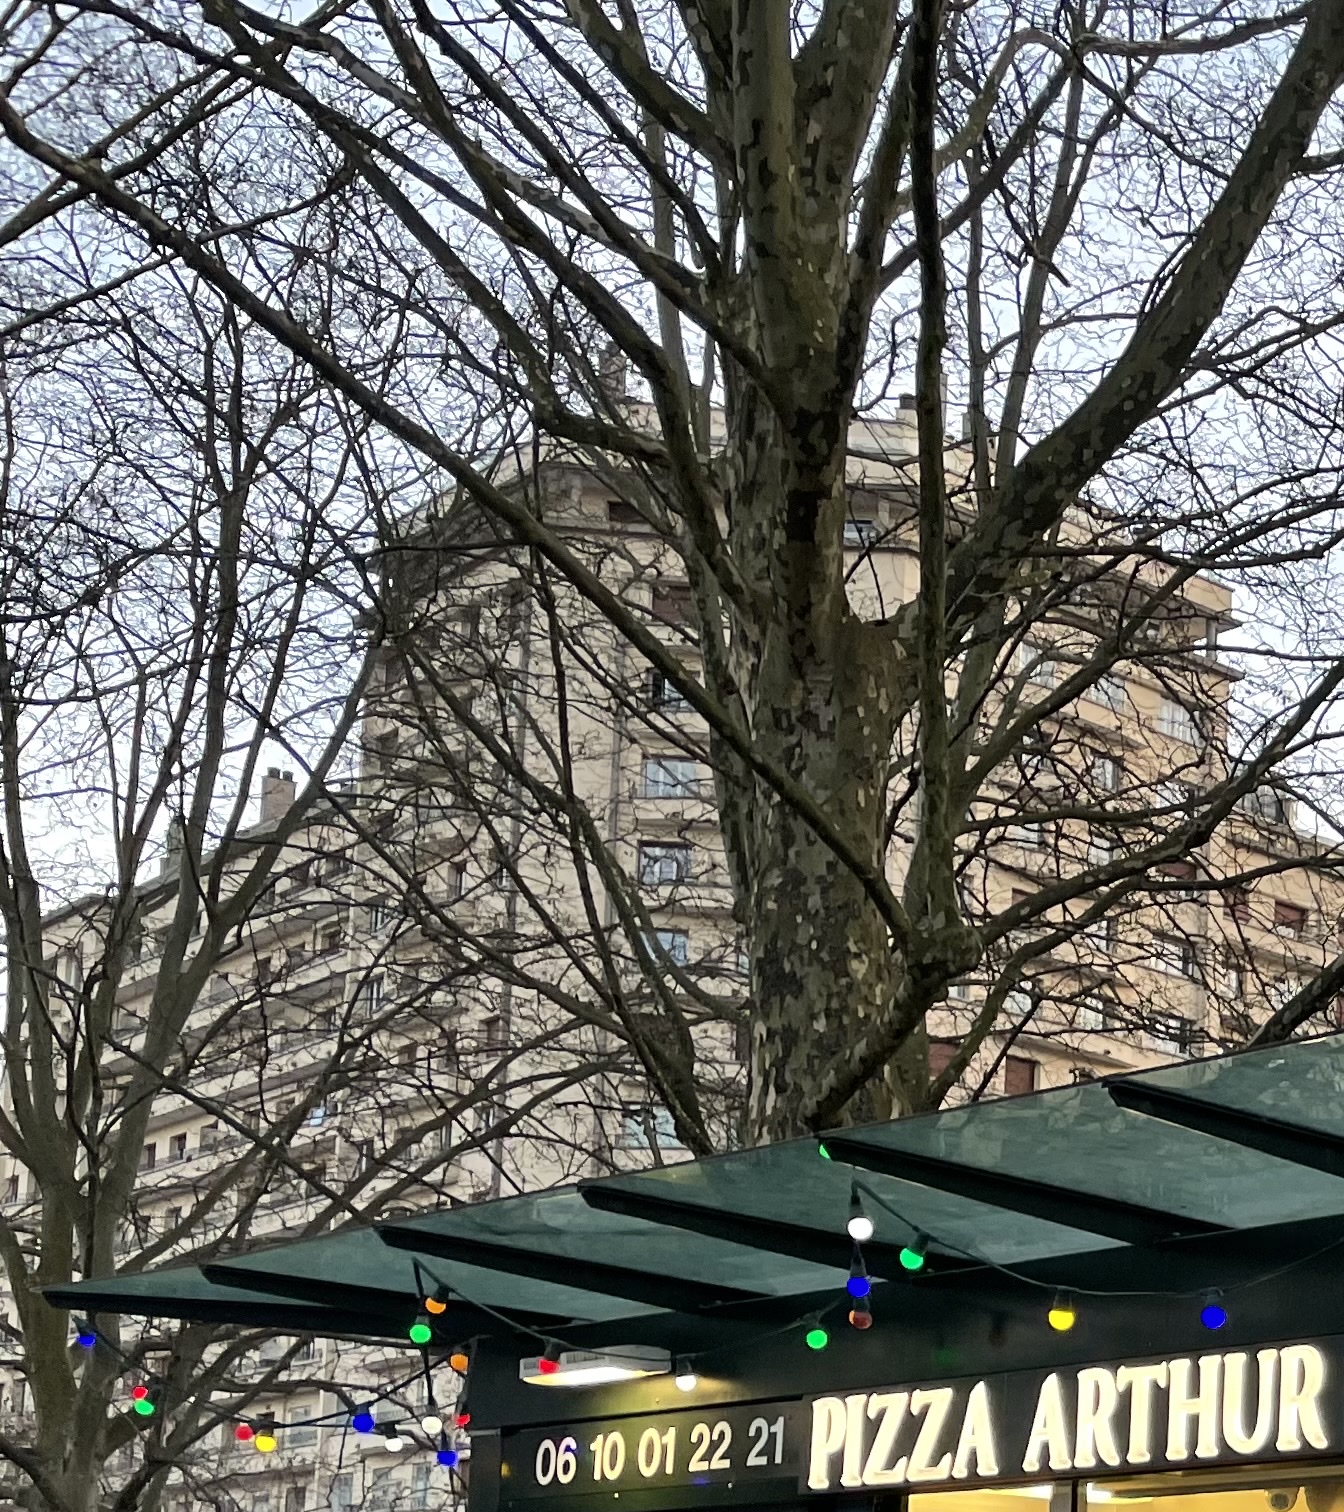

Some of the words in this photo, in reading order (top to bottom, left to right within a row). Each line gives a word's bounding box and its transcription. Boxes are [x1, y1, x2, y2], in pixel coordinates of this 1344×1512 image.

[534, 1437, 577, 1488] 06
[590, 1433, 626, 1484] 10
[637, 1427, 675, 1479] 01
[689, 1421, 733, 1475] 22
[746, 1417, 785, 1469] 21
[806, 1380, 1001, 1491] PIZZA
[1022, 1341, 1329, 1475] ARTHUR
